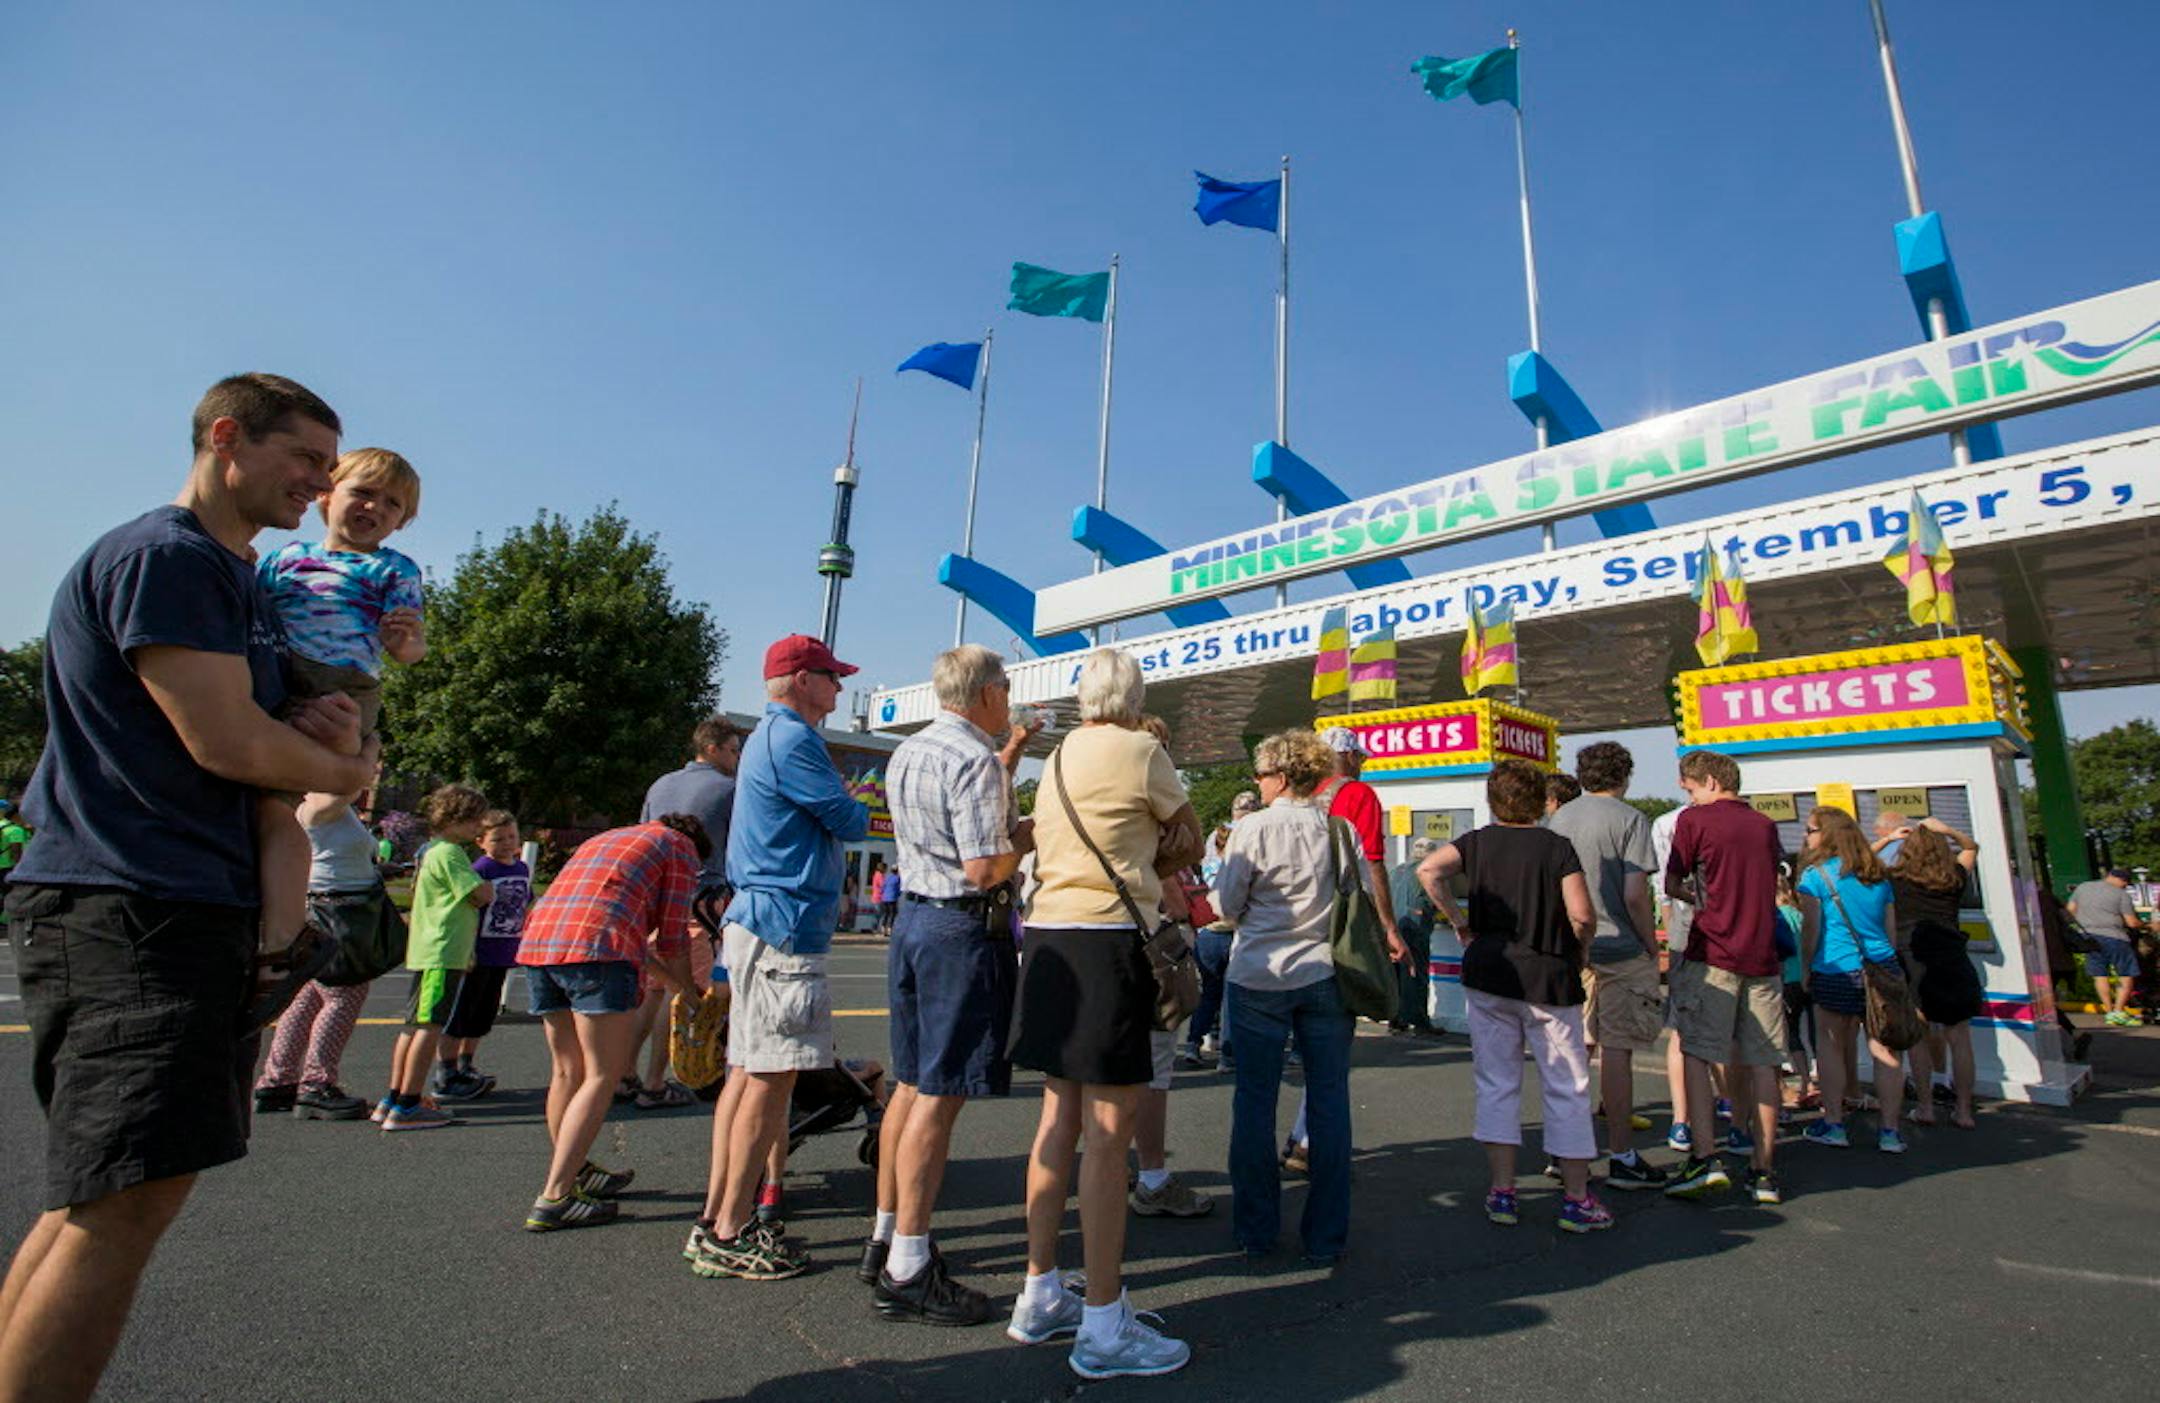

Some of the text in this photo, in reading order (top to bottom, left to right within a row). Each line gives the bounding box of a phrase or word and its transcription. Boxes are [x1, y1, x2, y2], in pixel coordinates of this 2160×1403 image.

[1171, 319, 2105, 595] MINNESOTA STATE FAIR
[1181, 637, 1221, 666] 25
[1234, 624, 1310, 656] thru
[1350, 596, 1453, 634] abor
[1465, 576, 1578, 610] Day,
[1721, 668, 1937, 720] TICKETS
[1357, 721, 1464, 753] ICKETS
[1756, 799, 1790, 811] OPEN
[1883, 793, 1923, 806] OPEN
